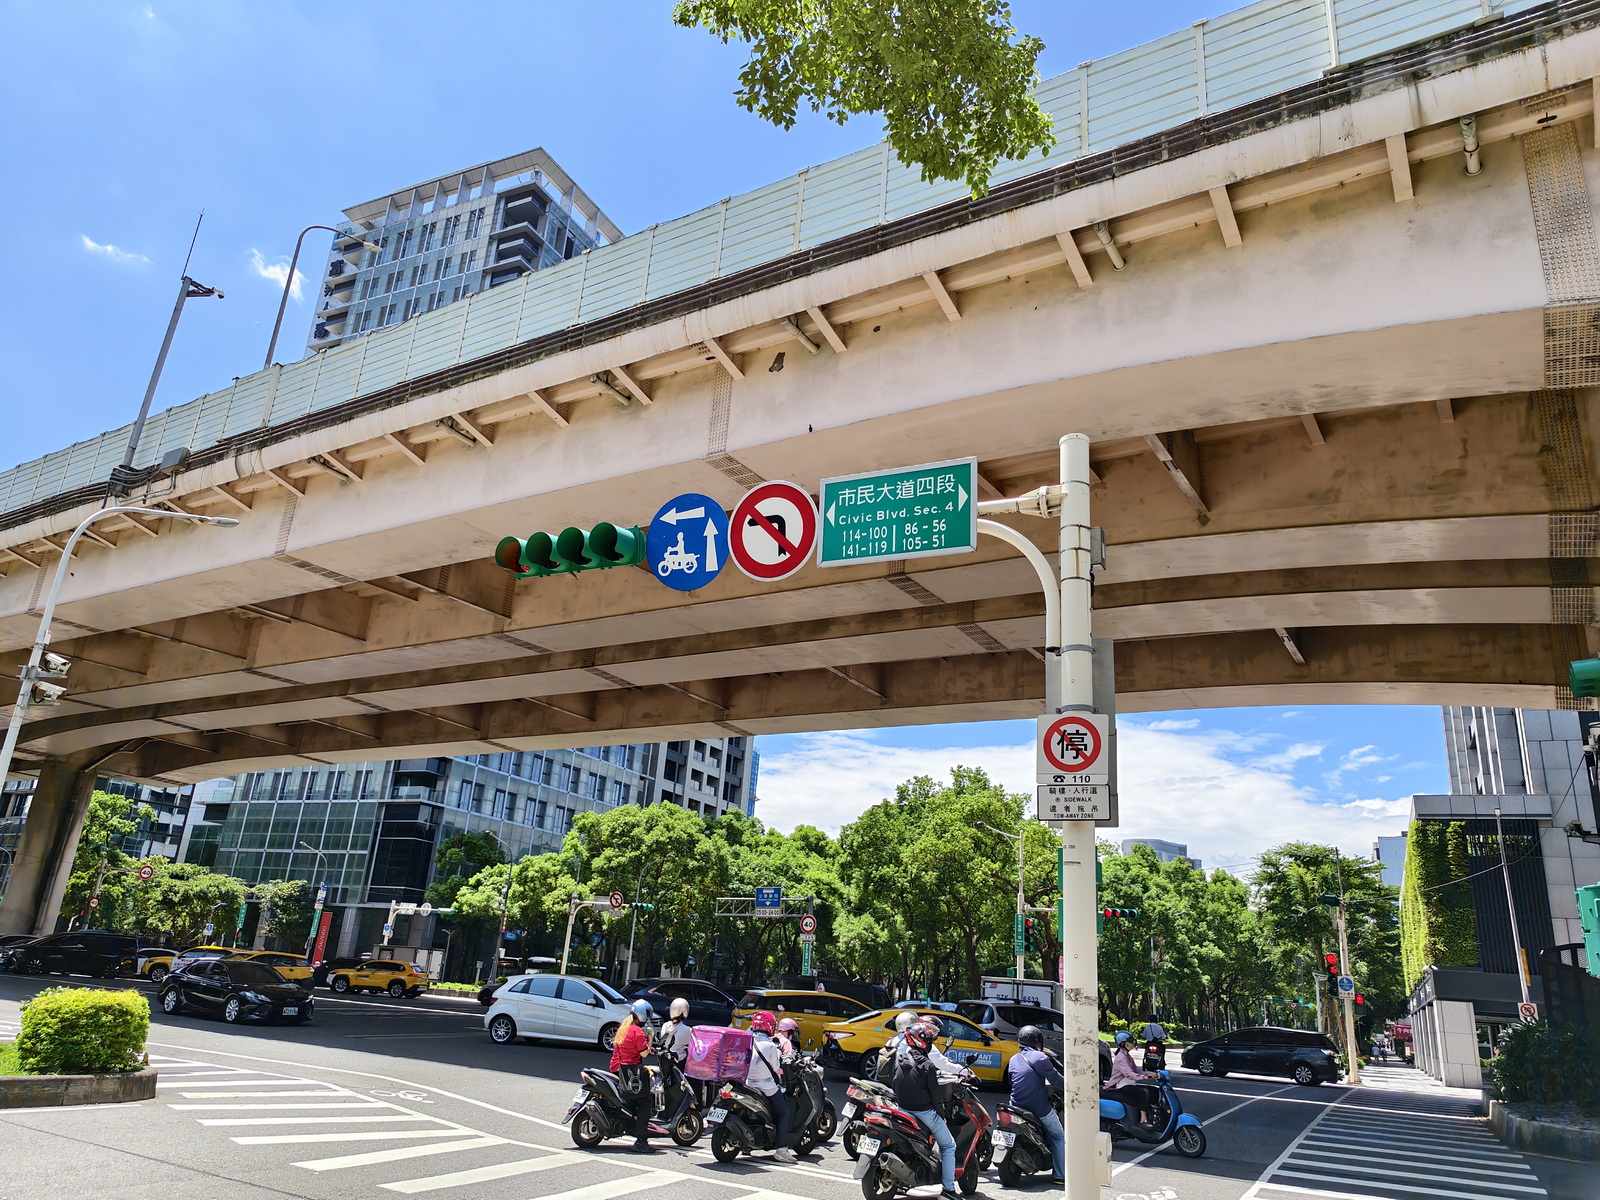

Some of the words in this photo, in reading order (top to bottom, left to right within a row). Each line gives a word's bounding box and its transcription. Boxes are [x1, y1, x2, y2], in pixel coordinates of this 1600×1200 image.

[838, 474, 955, 507] 市民大道四段
[838, 513, 872, 525] Civic
[876, 508, 910, 521] Blvd.
[914, 506, 941, 516] Sec.
[945, 501, 954, 512] 4
[843, 526, 888, 543] 114-100
[842, 540, 887, 557] 141-119
[1056, 729, 1088, 760] 停
[1071, 775, 1091, 783] 110
